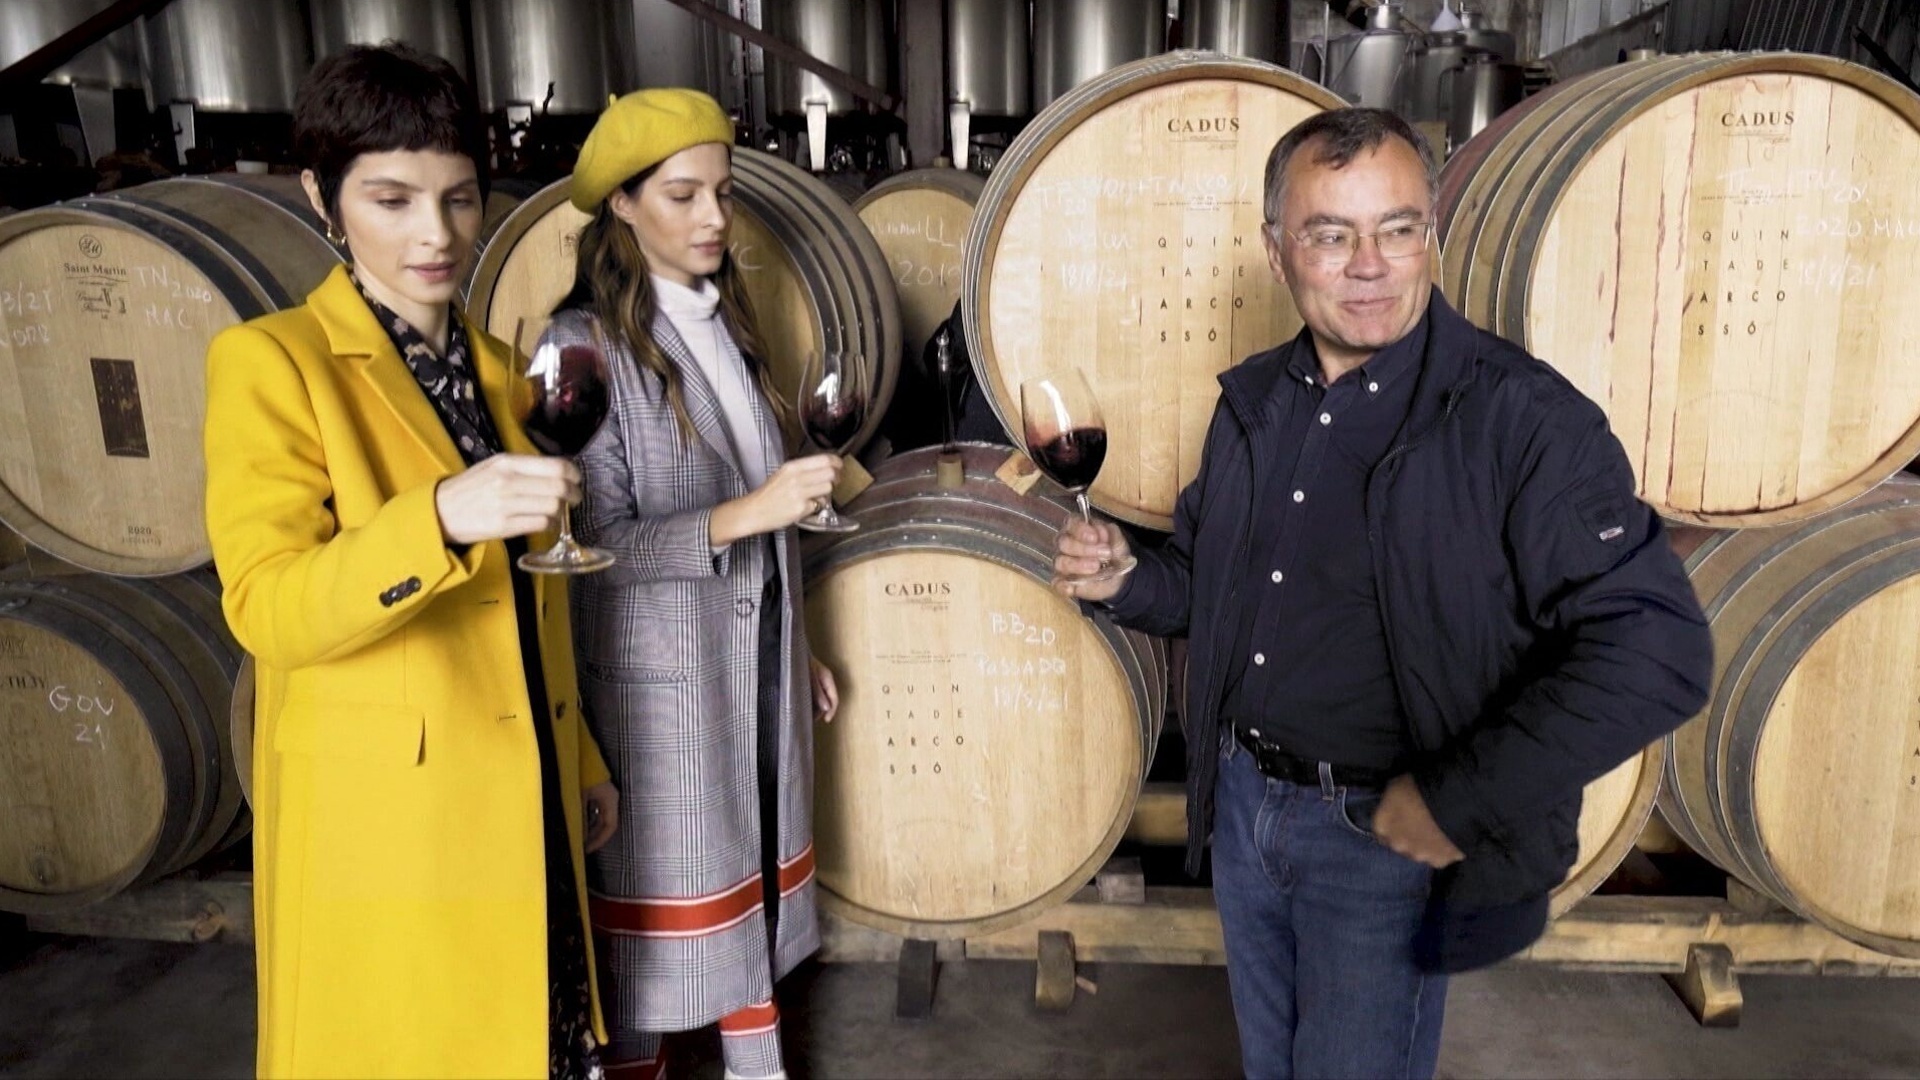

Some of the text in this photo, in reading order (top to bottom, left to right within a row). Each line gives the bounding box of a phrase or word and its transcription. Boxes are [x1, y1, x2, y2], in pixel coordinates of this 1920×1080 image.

[1167, 117, 1240, 132] CADUS
[1721, 111, 1794, 127] CADUS
[63, 263, 127, 275] Saint Martin
[885, 582, 951, 596] CADUS
